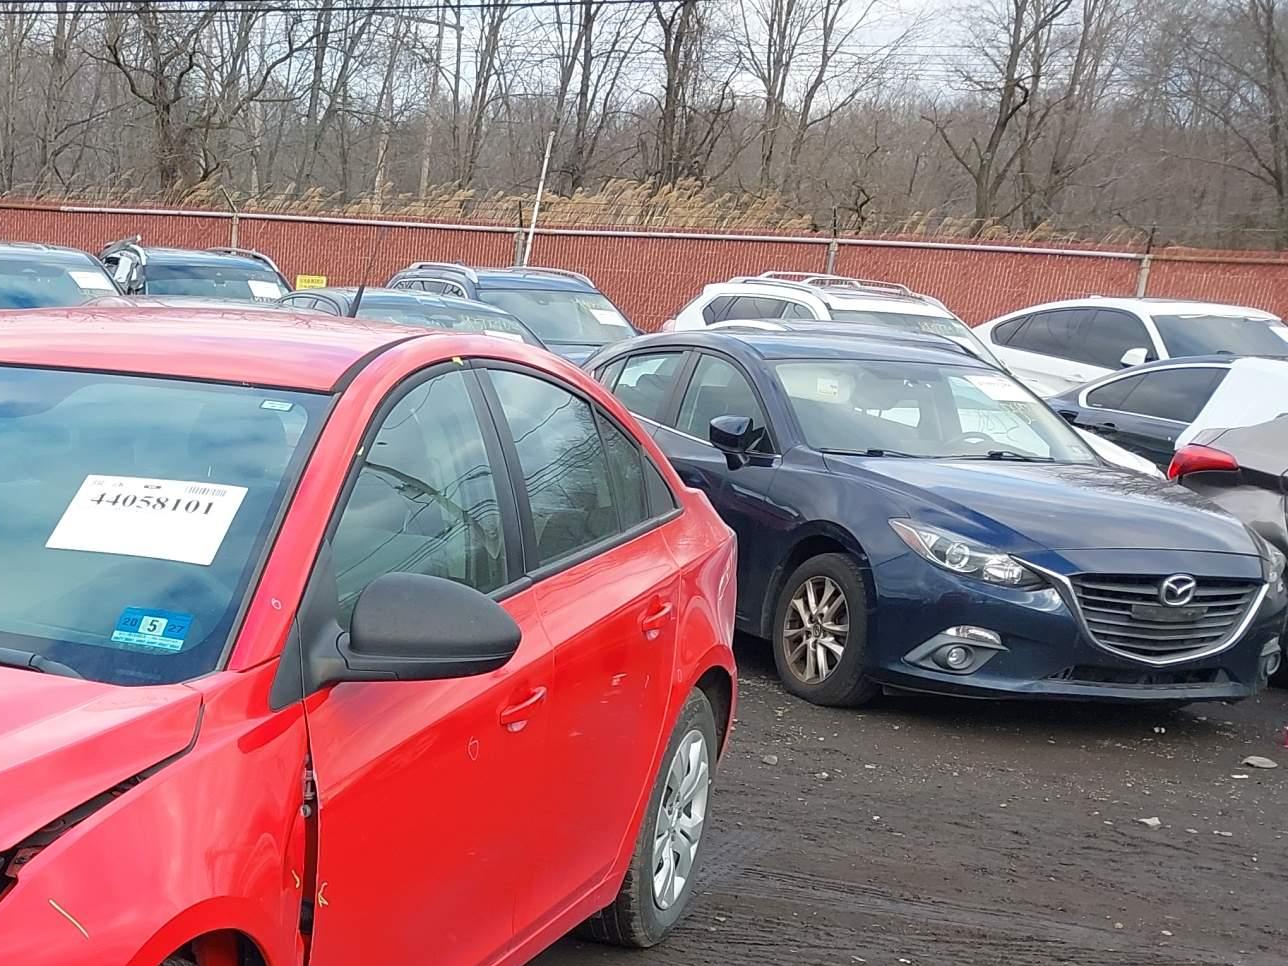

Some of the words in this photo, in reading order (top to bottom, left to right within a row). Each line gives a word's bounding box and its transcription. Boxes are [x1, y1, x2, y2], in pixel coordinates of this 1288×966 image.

[90, 492, 214, 515] 44058101
[146, 619, 160, 633] 5
[167, 624, 185, 634] 27
